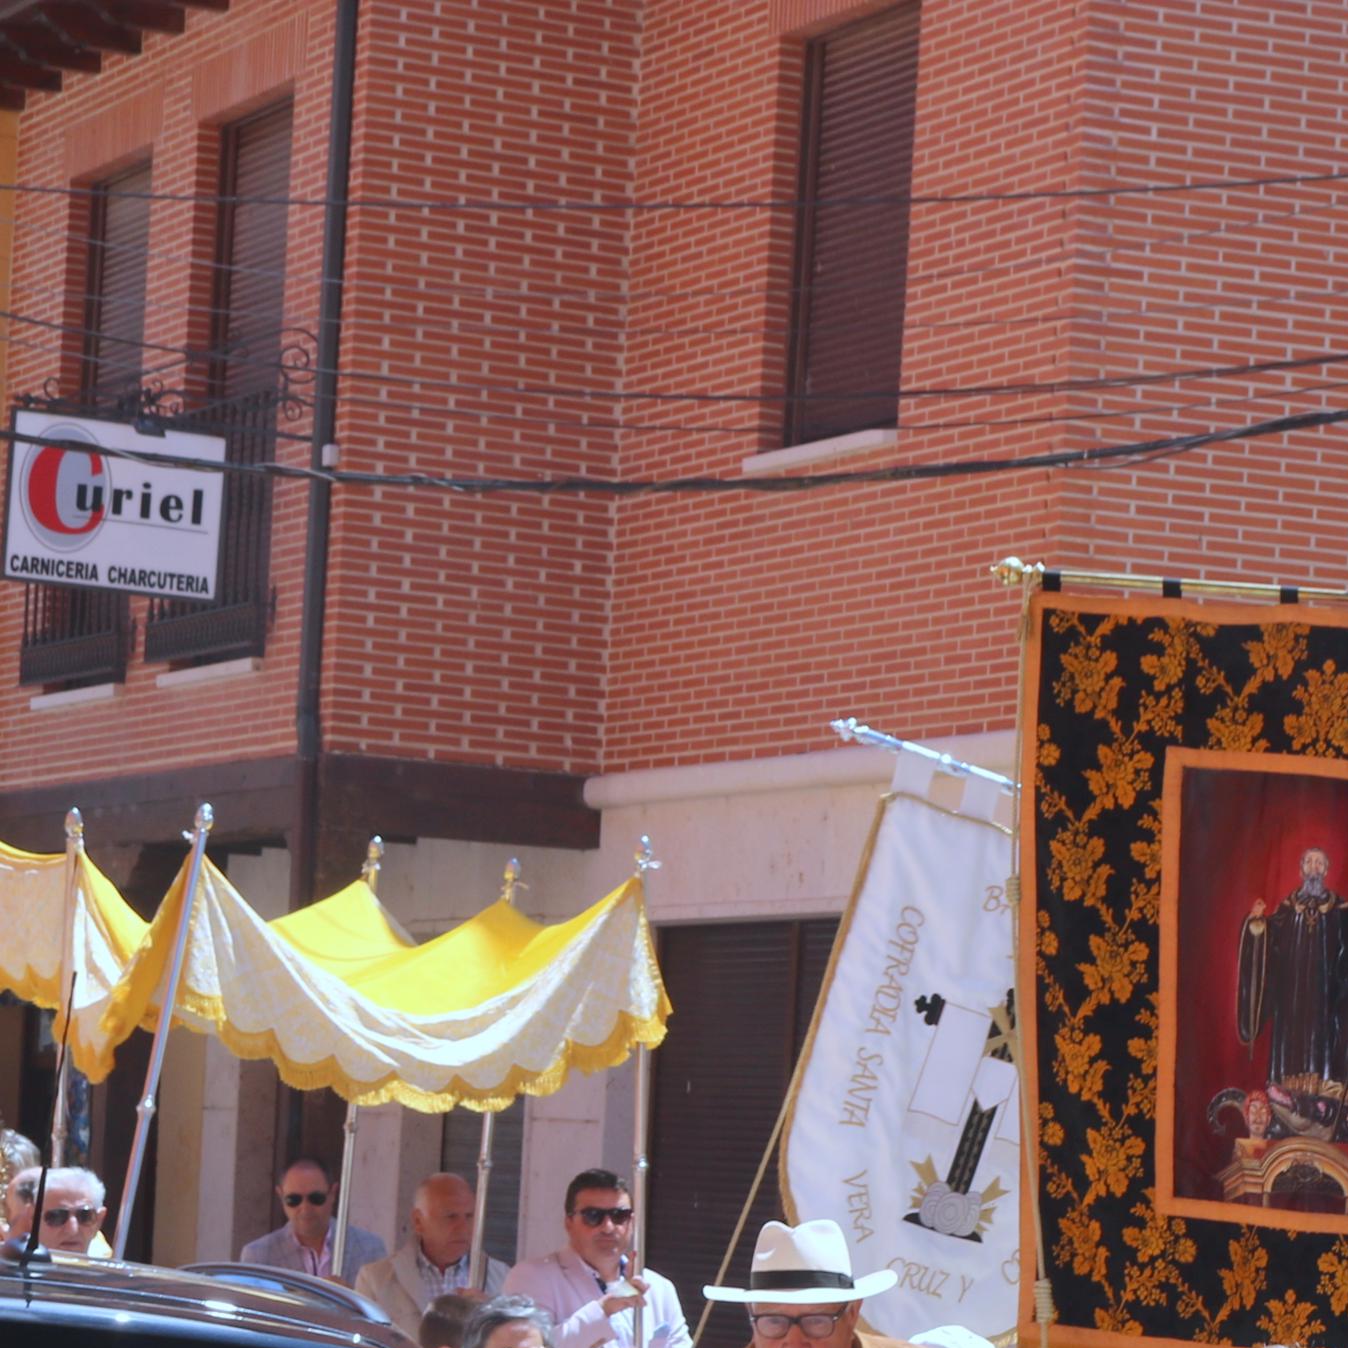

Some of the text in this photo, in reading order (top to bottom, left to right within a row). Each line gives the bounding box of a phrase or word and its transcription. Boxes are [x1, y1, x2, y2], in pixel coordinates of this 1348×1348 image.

[28, 445, 204, 535] Curiel
[10, 554, 209, 594] CARNICERIA CHARCUTERIA
[838, 1047, 884, 1128] SANTA
[842, 1169, 875, 1244] VERA
[958, 1274, 975, 1303] Y
